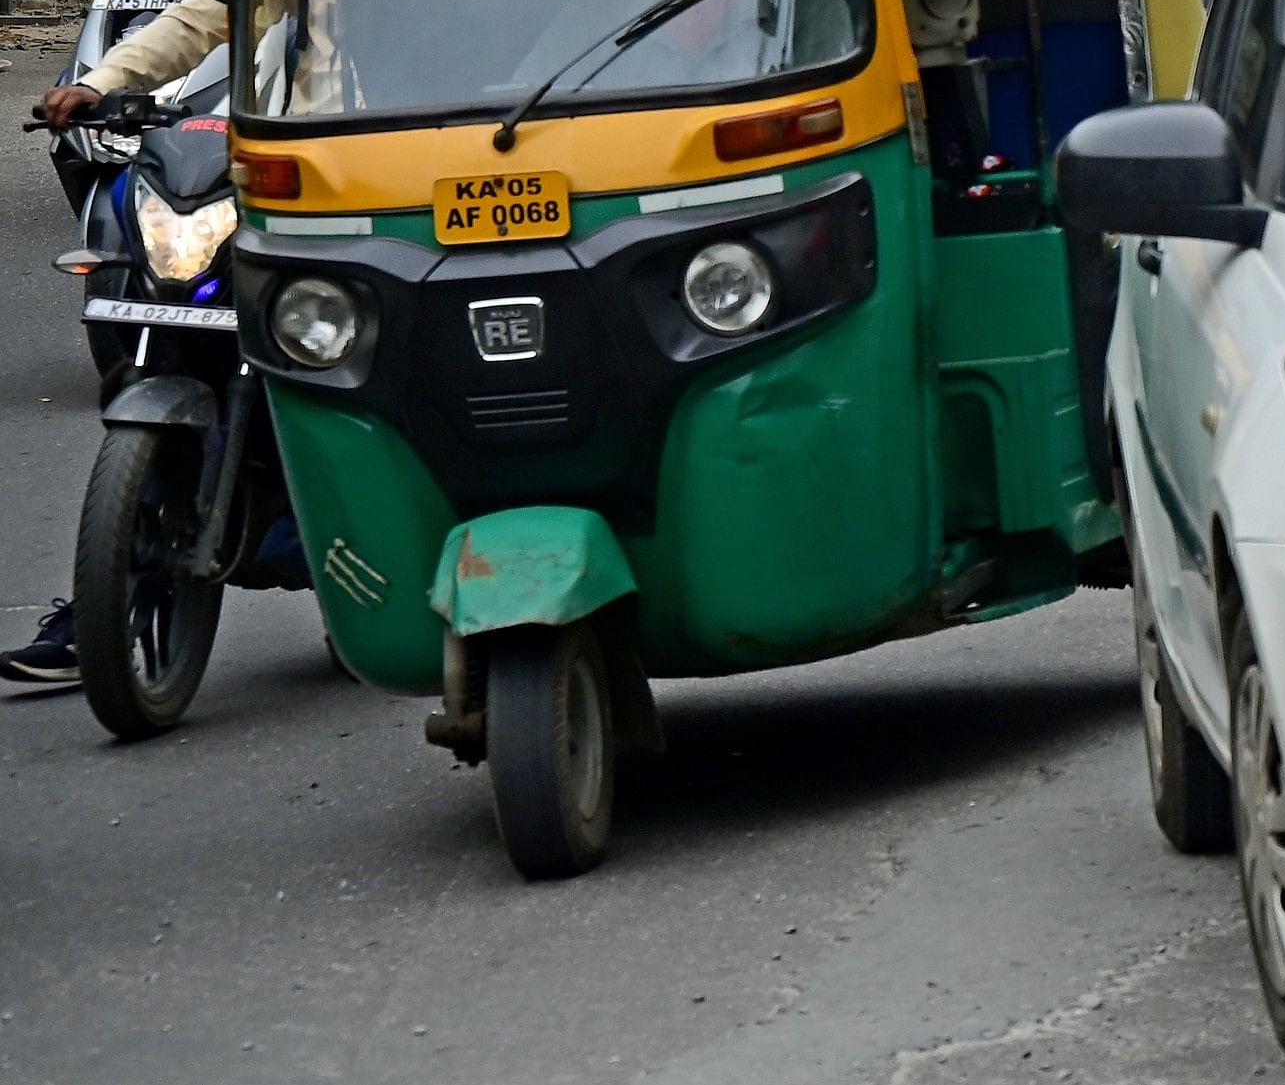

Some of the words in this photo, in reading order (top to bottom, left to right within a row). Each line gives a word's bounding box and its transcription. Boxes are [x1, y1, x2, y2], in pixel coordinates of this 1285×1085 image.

[456, 180, 498, 201] KA
[508, 177, 543, 197] 05
[446, 206, 481, 230] AF
[491, 200, 560, 227] 0068
